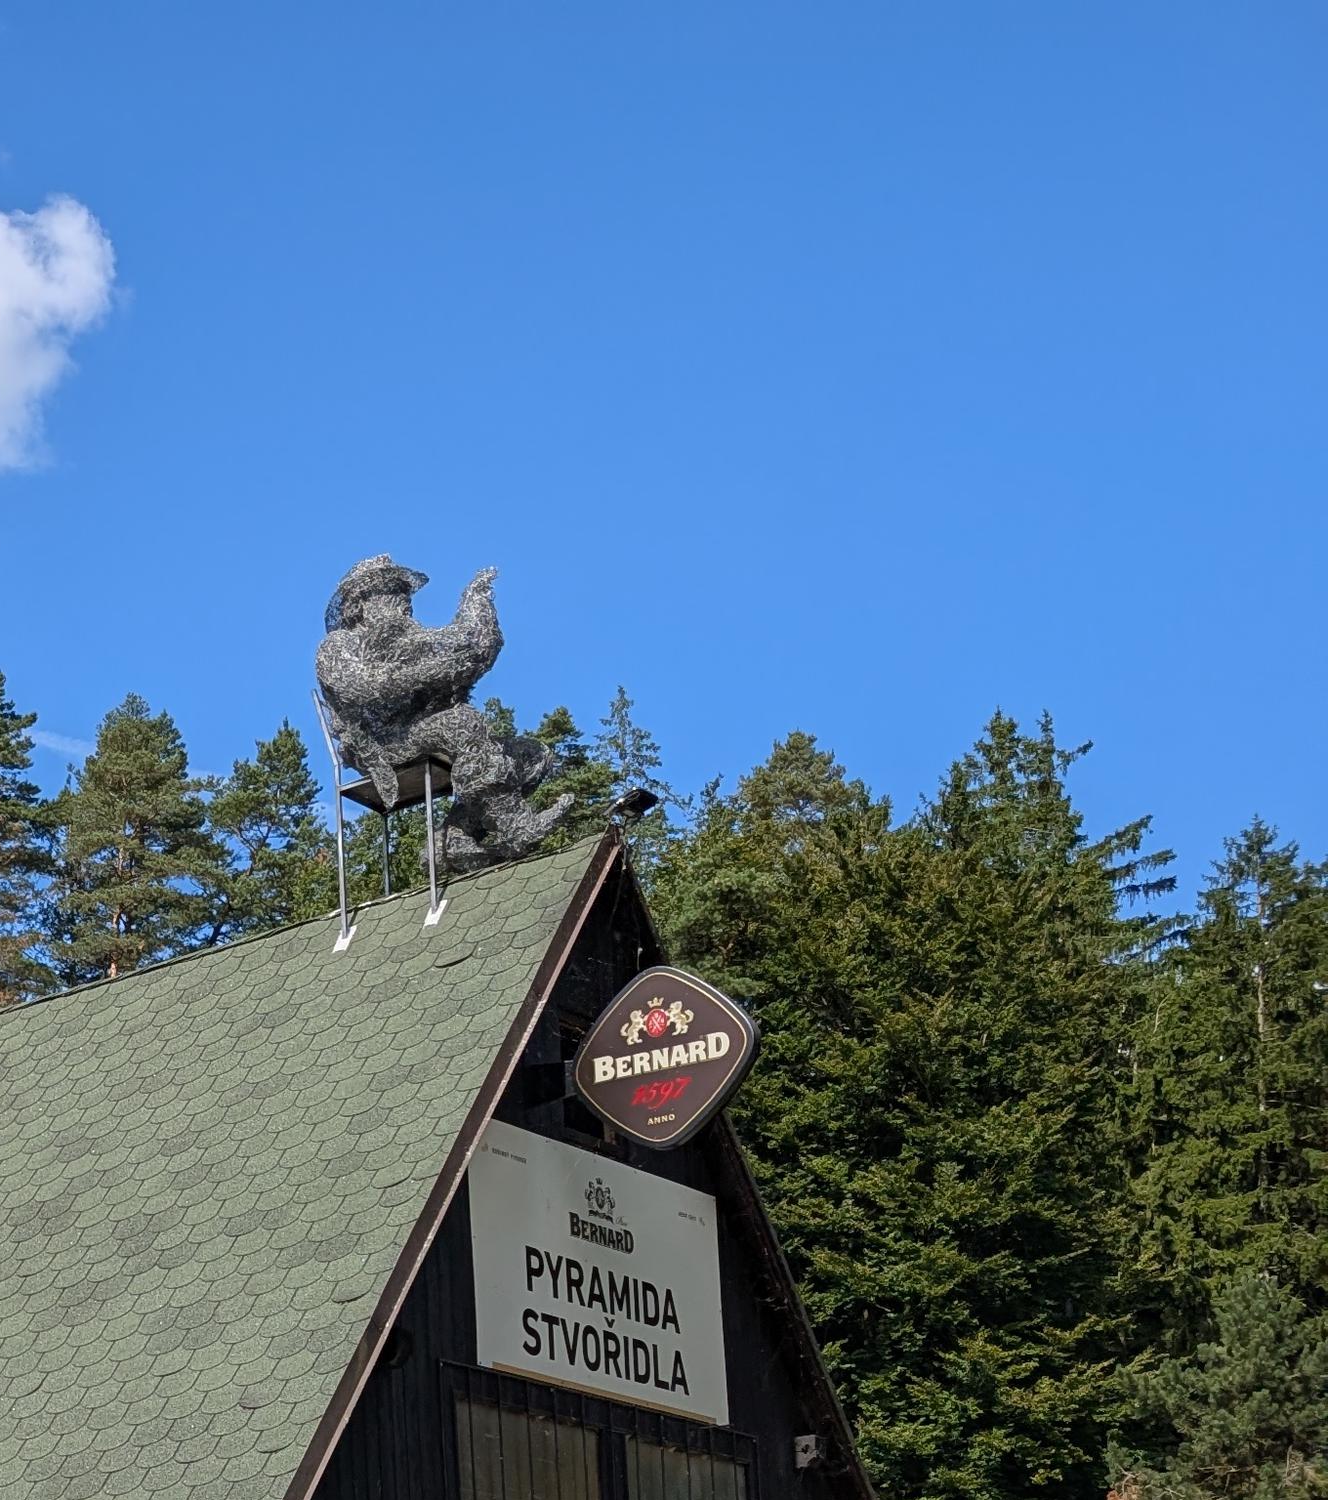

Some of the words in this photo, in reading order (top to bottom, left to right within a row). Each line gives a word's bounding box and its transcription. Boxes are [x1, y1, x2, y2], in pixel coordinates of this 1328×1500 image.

[593, 1031, 731, 1084] BERNARD
[631, 1076, 692, 1110] 1597
[647, 1113, 676, 1125] ANNO
[569, 1211, 634, 1255] BERNARD
[525, 1245, 681, 1334] PYRAMIDA
[522, 1308, 690, 1396] STVOŘIDLA
